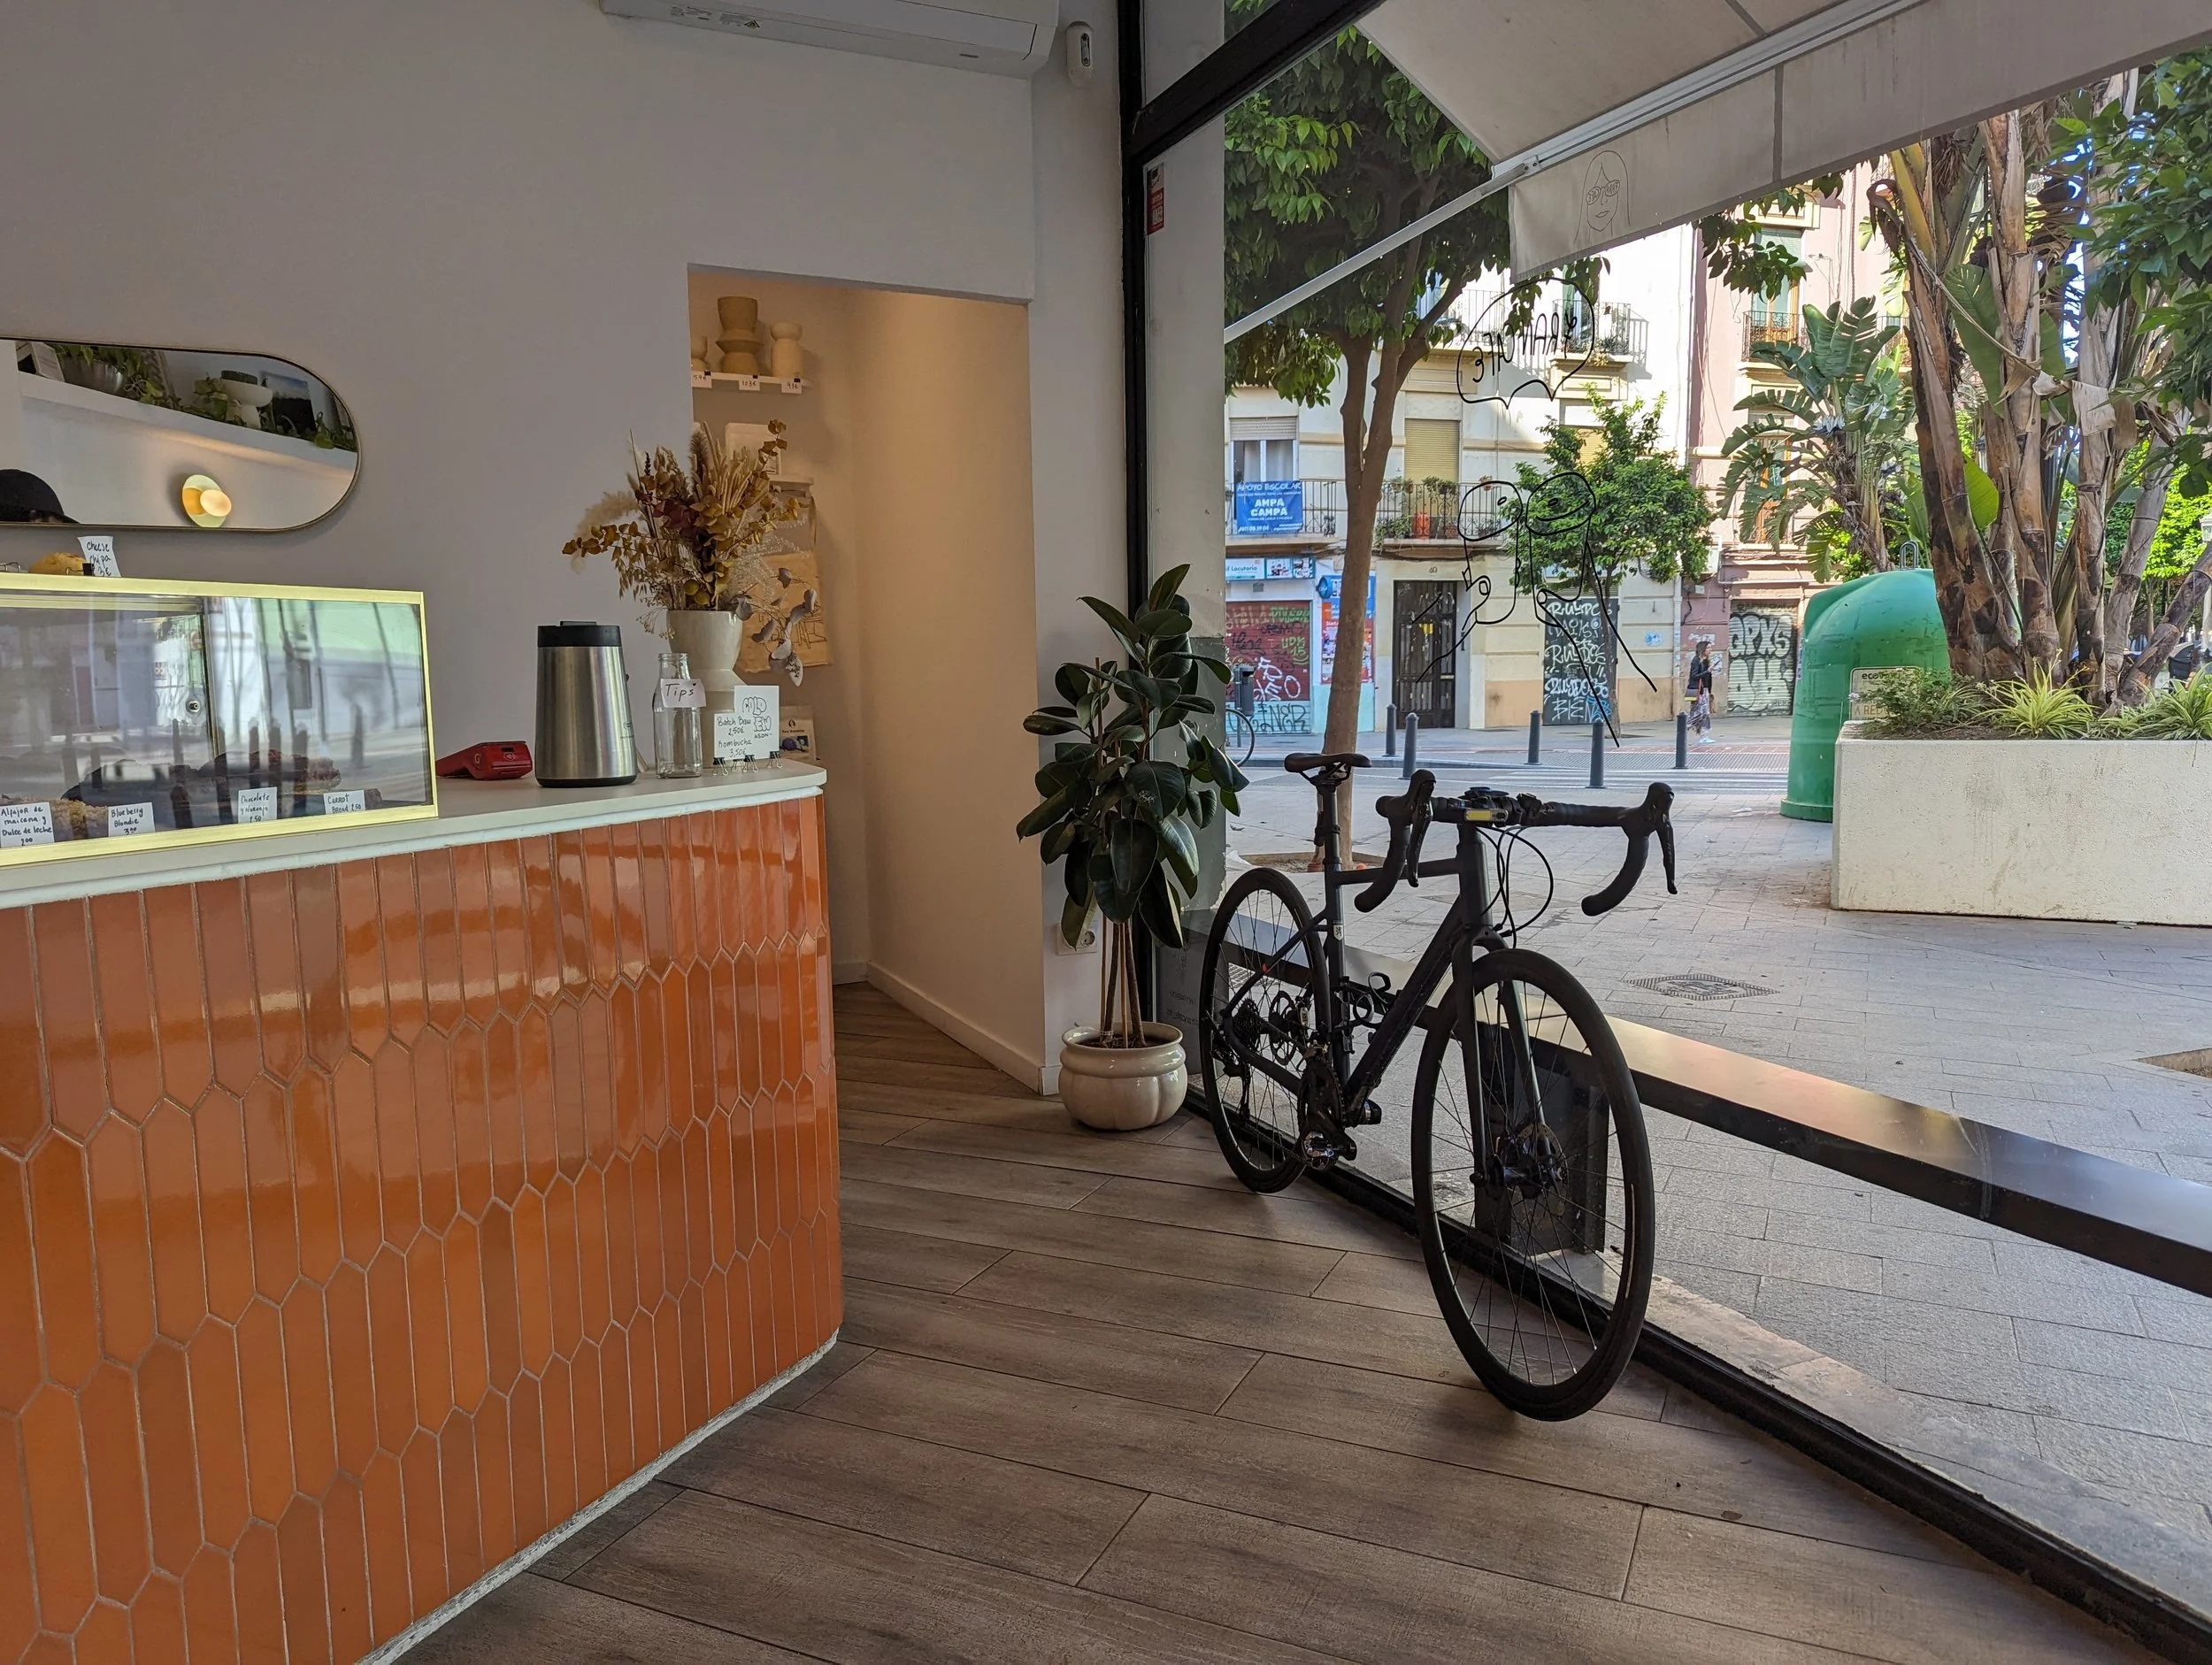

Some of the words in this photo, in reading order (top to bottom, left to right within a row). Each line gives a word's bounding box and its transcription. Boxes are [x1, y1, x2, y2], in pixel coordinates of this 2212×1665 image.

[1237, 483, 1263, 492] APOYO
[1264, 482, 1302, 491] ESCOLAR
[1255, 498, 1285, 508] AMPA
[1250, 507, 1288, 517] CAMPA
[664, 682, 695, 702] Tips
[717, 716, 736, 726] Batch
[718, 739, 753, 748] Kombucha
[4, 817, 38, 825] maicena
[113, 817, 140, 828] Blondie
[2, 828, 22, 837] Dulce
